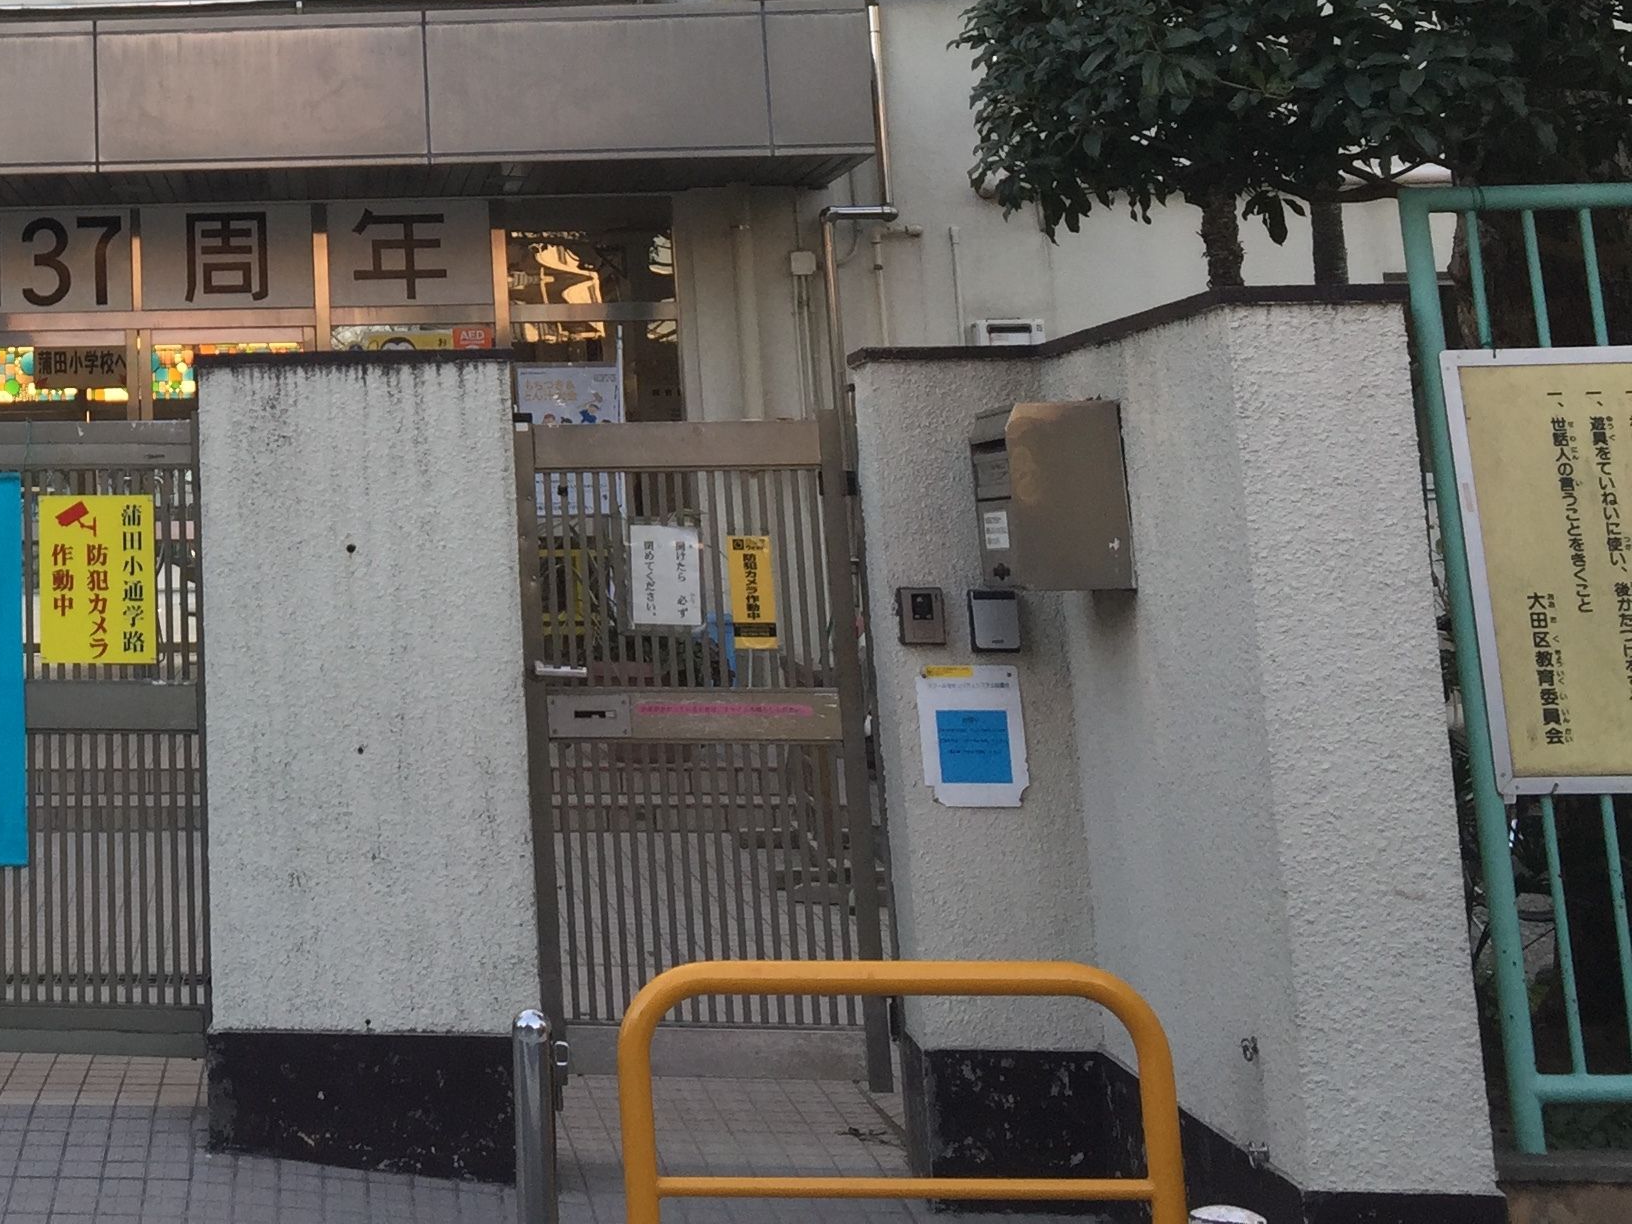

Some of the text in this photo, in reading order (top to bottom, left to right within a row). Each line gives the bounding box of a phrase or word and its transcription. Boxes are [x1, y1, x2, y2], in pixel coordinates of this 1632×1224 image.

[37, 350, 126, 375] 蒲田小学校へ
[459, 330, 485, 340] AED
[51, 544, 74, 617] 作動中
[121, 504, 145, 654] 蒲田小通学路
[675, 541, 688, 582] 開けたら
[742, 553, 761, 620] 防犯カメラ作動中
[86, 544, 109, 659] 防犯カメラ
[1527, 592, 1565, 745] 大田区教育委員会
